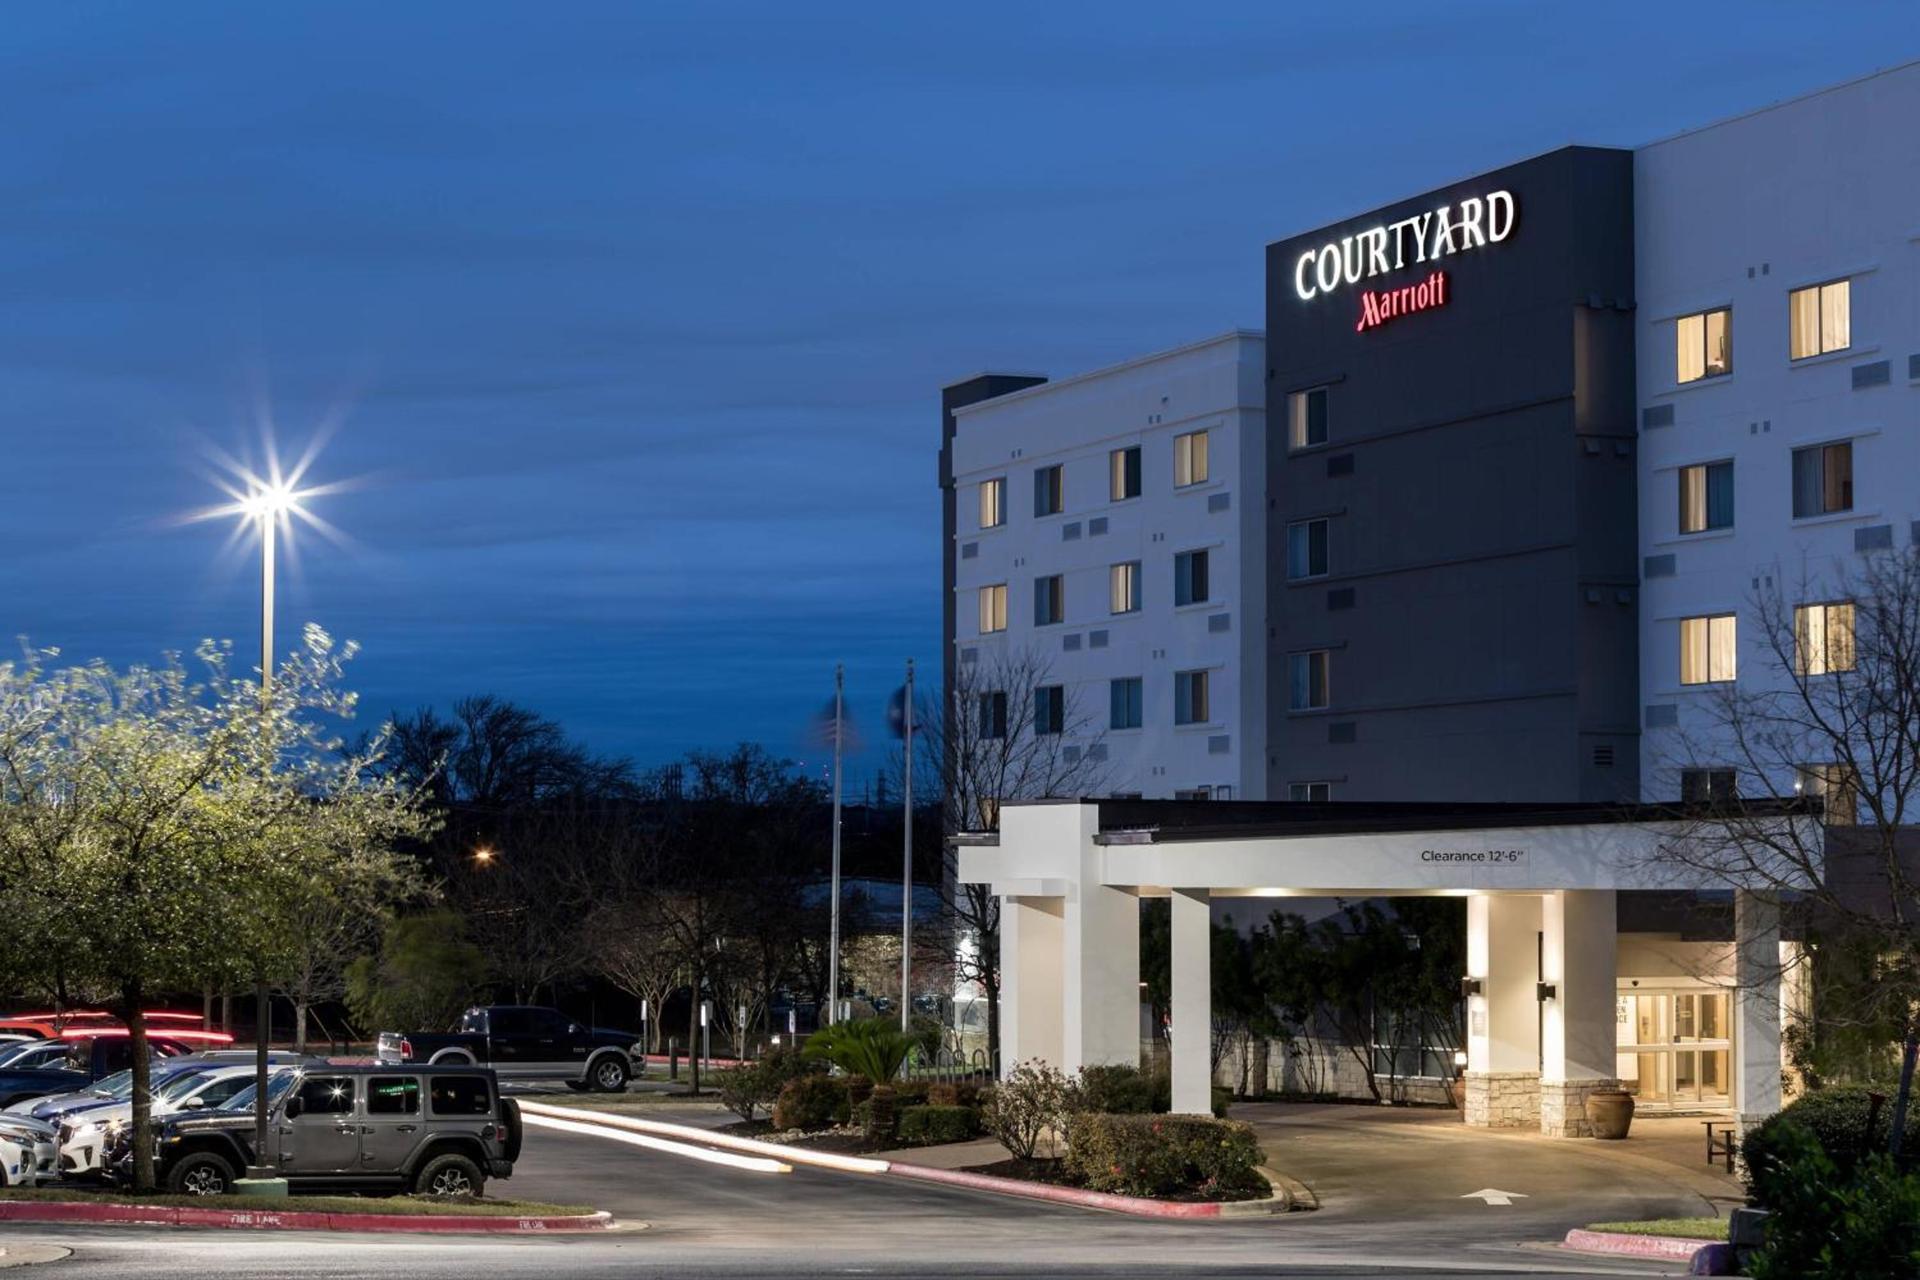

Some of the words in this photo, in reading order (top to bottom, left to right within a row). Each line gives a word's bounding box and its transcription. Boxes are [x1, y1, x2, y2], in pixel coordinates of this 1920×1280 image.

[1295, 190, 1515, 300] COURTYARD
[1357, 271, 1445, 332] Marriott
[1421, 850, 1485, 861] Clearance
[231, 1214, 253, 1225] FIRE
